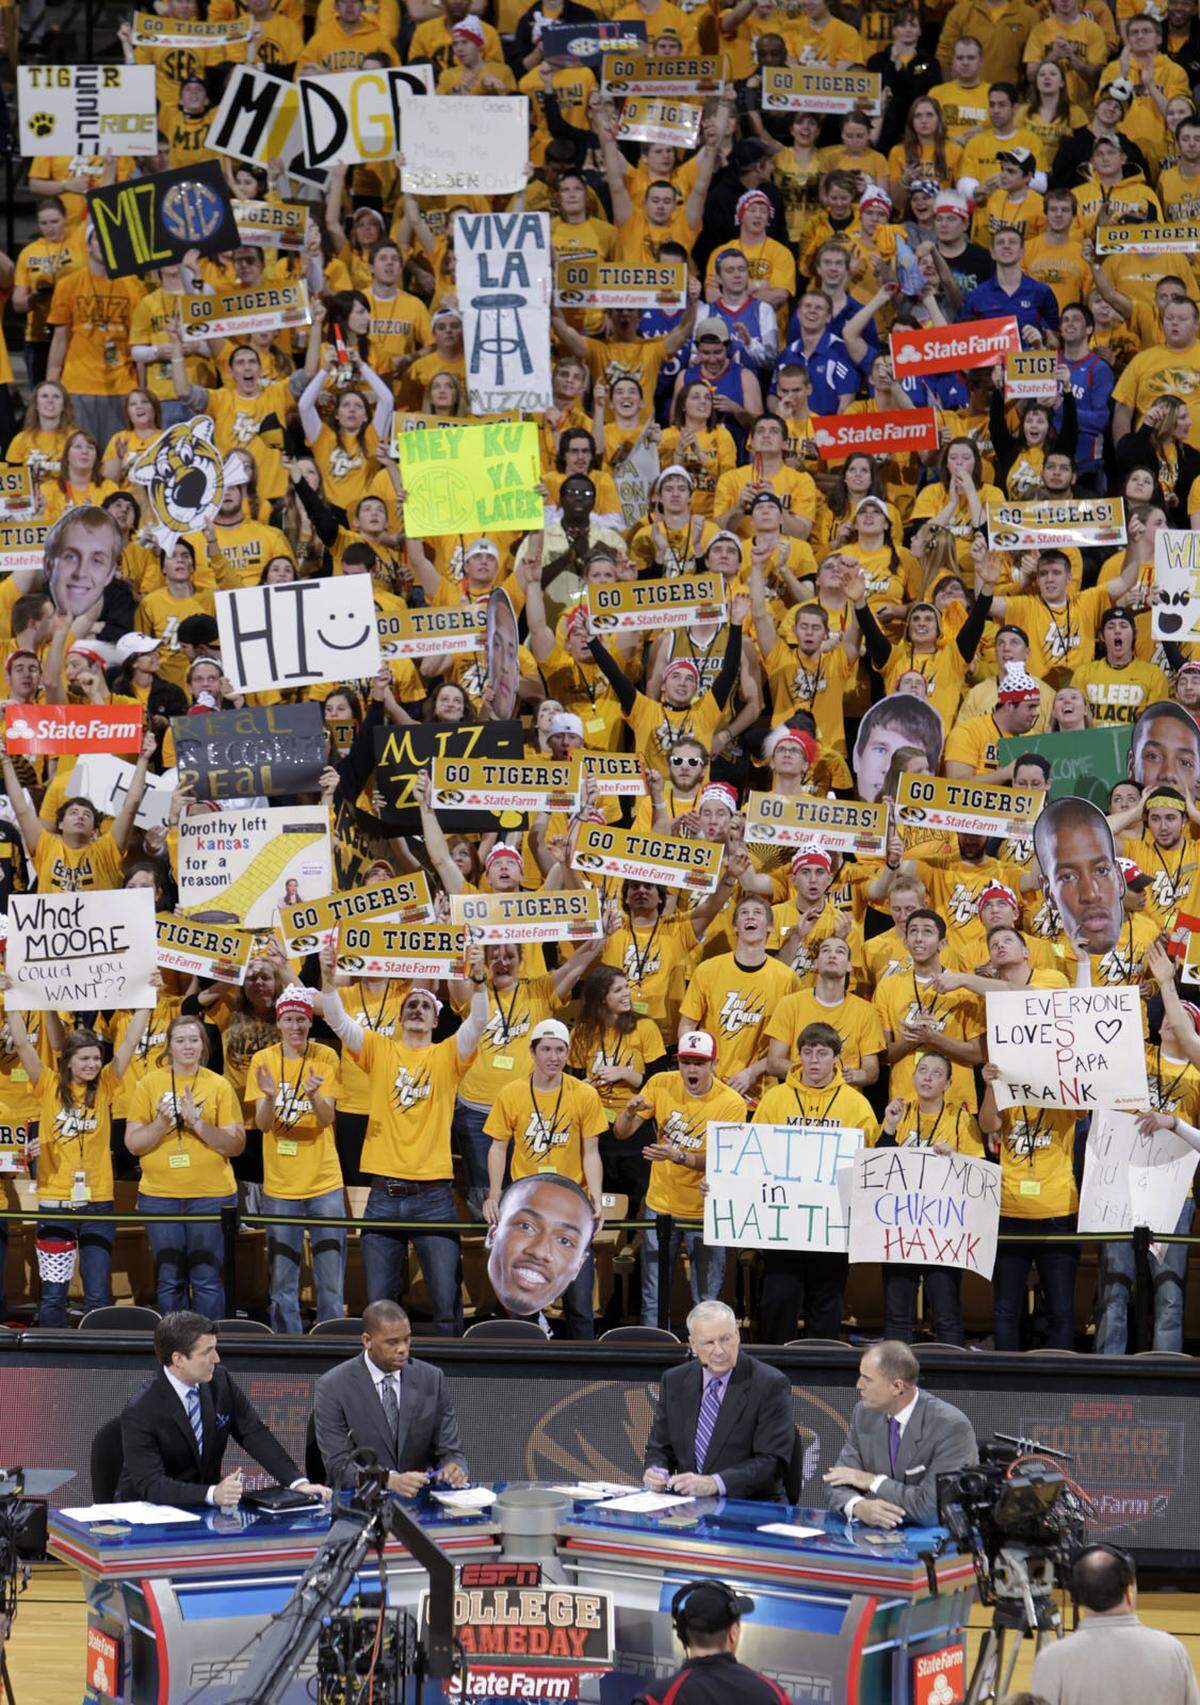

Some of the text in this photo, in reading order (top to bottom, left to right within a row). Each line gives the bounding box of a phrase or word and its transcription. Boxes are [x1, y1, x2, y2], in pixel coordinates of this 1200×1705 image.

[143, 19, 244, 33] GO TIGERS!
[613, 60, 716, 76] GO TIGERS!
[774, 73, 871, 93] GO TIGERS!
[458, 214, 545, 251] VIVA
[1108, 230, 1129, 241] GO
[478, 252, 530, 289] LA
[567, 268, 676, 285] GO TIGERS!
[190, 287, 298, 318] GO TIGERS!
[599, 294, 649, 304] StateFarm
[923, 335, 1012, 362] StateFarm
[468, 388, 551, 413] MIZZOU
[403, 424, 524, 465] HEY KU
[836, 423, 927, 446] StateFarm
[486, 461, 524, 491] YA
[1000, 509, 1022, 524] GO
[598, 581, 715, 608] GO TIGERS!
[377, 611, 488, 636] GO TIGERS
[636, 612, 689, 625] StateFarm
[228, 582, 324, 687] HI
[415, 637, 467, 652] StateFarm
[36, 719, 136, 740] StateFarm
[446, 764, 570, 786] GO TIGERS!
[483, 794, 538, 806] StateFarm
[909, 781, 1032, 815] GO TIGERS!
[760, 799, 878, 828] GO TIGERS!
[944, 815, 999, 832] StateFarm
[181, 817, 267, 837] Dorothy left
[197, 836, 250, 851] kansas
[588, 831, 712, 867] GO TIGERS!
[185, 857, 227, 870] for a
[621, 863, 677, 882] StateFarm
[181, 873, 232, 887] reason!
[11, 897, 86, 932] What
[292, 881, 417, 930] GO TIGERS!
[463, 896, 588, 919] GO TIGERS!
[26, 925, 130, 960] MOORE
[156, 920, 241, 957] TIGERS!
[346, 929, 466, 952] GO TIGERS
[504, 926, 559, 940] StateFarm
[89, 961, 125, 982] you
[384, 961, 441, 975] StateFarm
[45, 975, 127, 1002] WANT??
[1026, 991, 1133, 1019] EVERYONE
[995, 1019, 1075, 1048] LOVES
[1056, 1049, 1109, 1076] PAPA
[1008, 1076, 1098, 1105] FRANK
[713, 1123, 860, 1186] FAITH
[860, 1152, 1000, 1207] EAT MOR
[761, 1183, 787, 1205] in
[712, 1199, 851, 1247] HAITH
[874, 1192, 967, 1229] CHIKIN
[884, 1227, 982, 1270] HAWK
[1071, 1402, 1134, 1420] ESPN
[462, 1564, 541, 1586] ESPN
[426, 1590, 601, 1630] OLLEGE
[453, 1624, 589, 1659] AMEDAY
[915, 1650, 964, 1678] StateFarm
[449, 1671, 571, 1698] StateFarm
